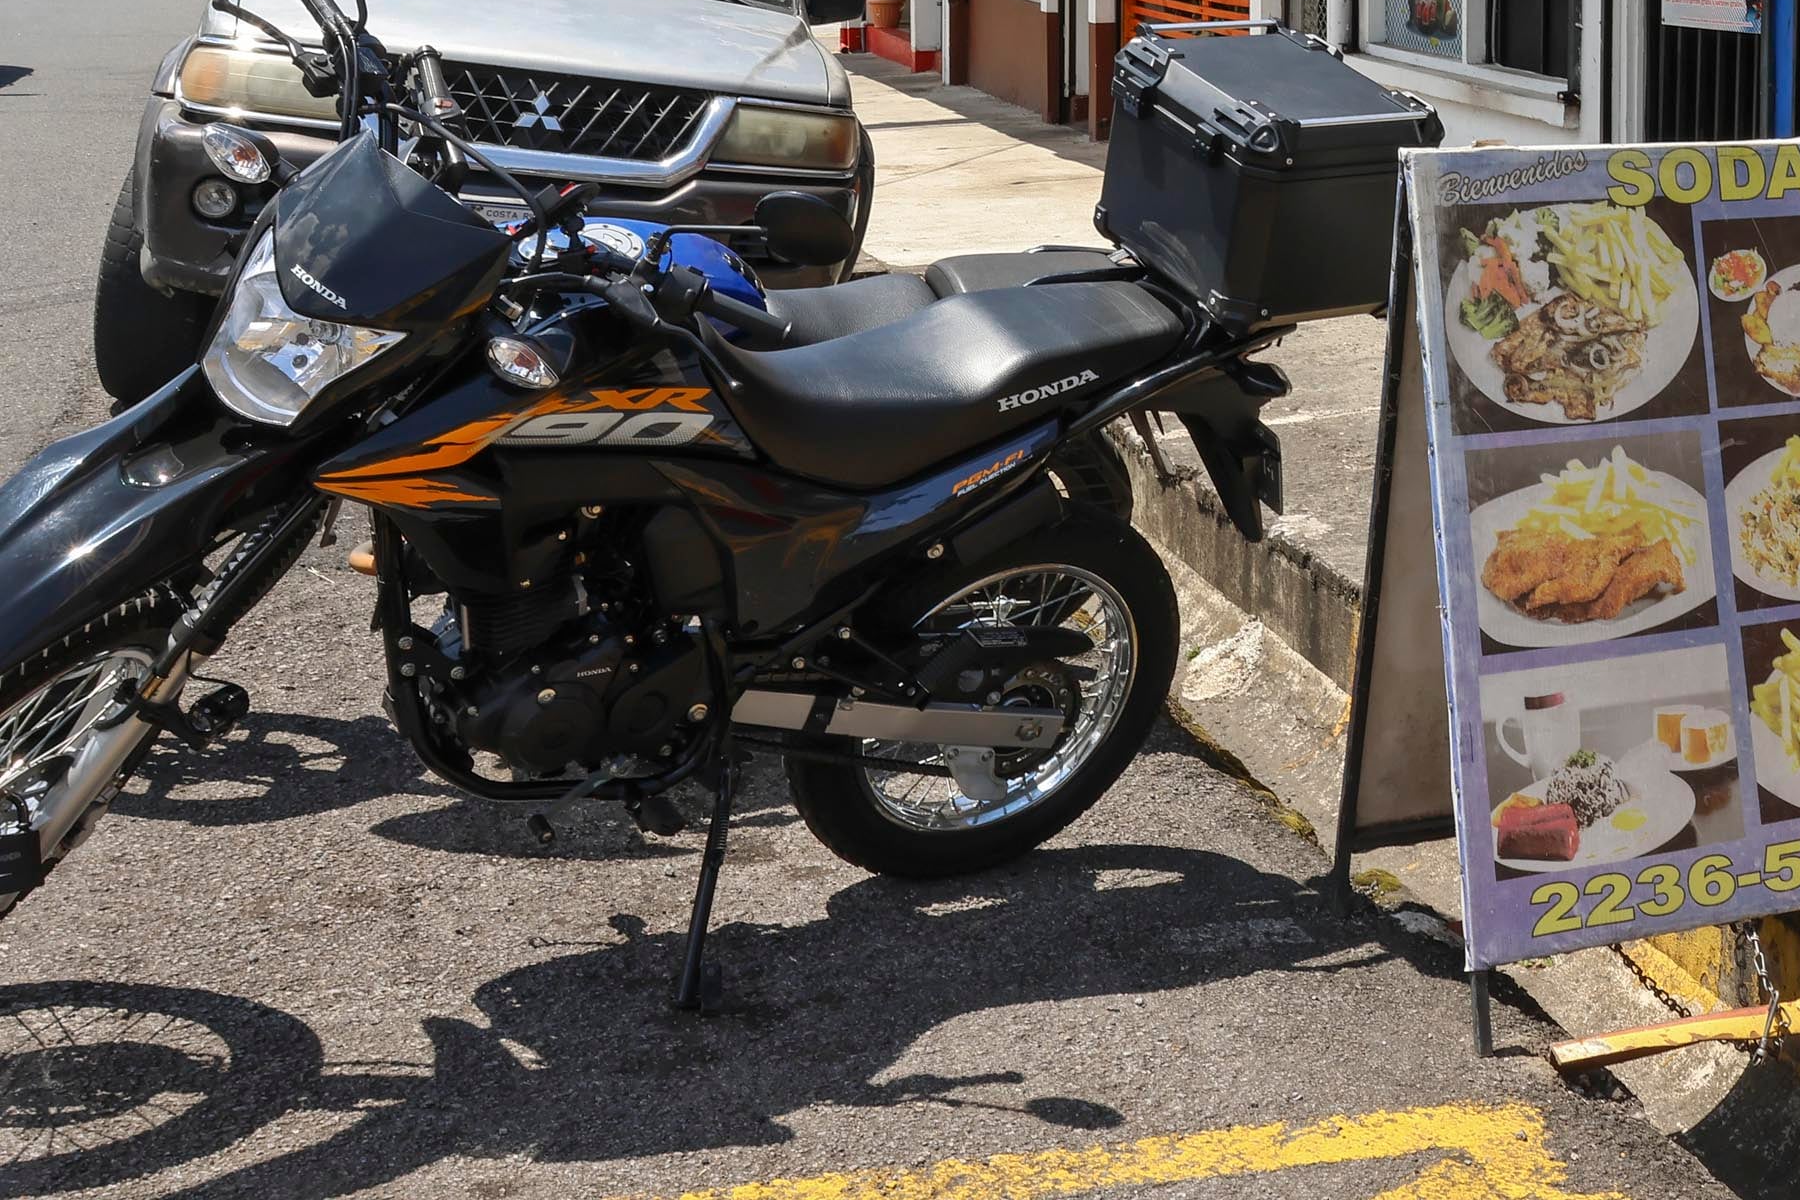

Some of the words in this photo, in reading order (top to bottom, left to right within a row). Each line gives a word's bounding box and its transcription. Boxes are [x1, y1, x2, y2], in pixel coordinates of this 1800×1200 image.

[1438, 149, 1589, 206] Bienvenidos
[486, 209, 518, 219] COSTA
[290, 263, 348, 311] HONDA
[580, 387, 713, 412] XR
[996, 369, 1100, 413] HONDA
[952, 449, 1025, 495] PGM-FI
[957, 483, 979, 498] FUEL
[576, 666, 612, 678] HONDA
